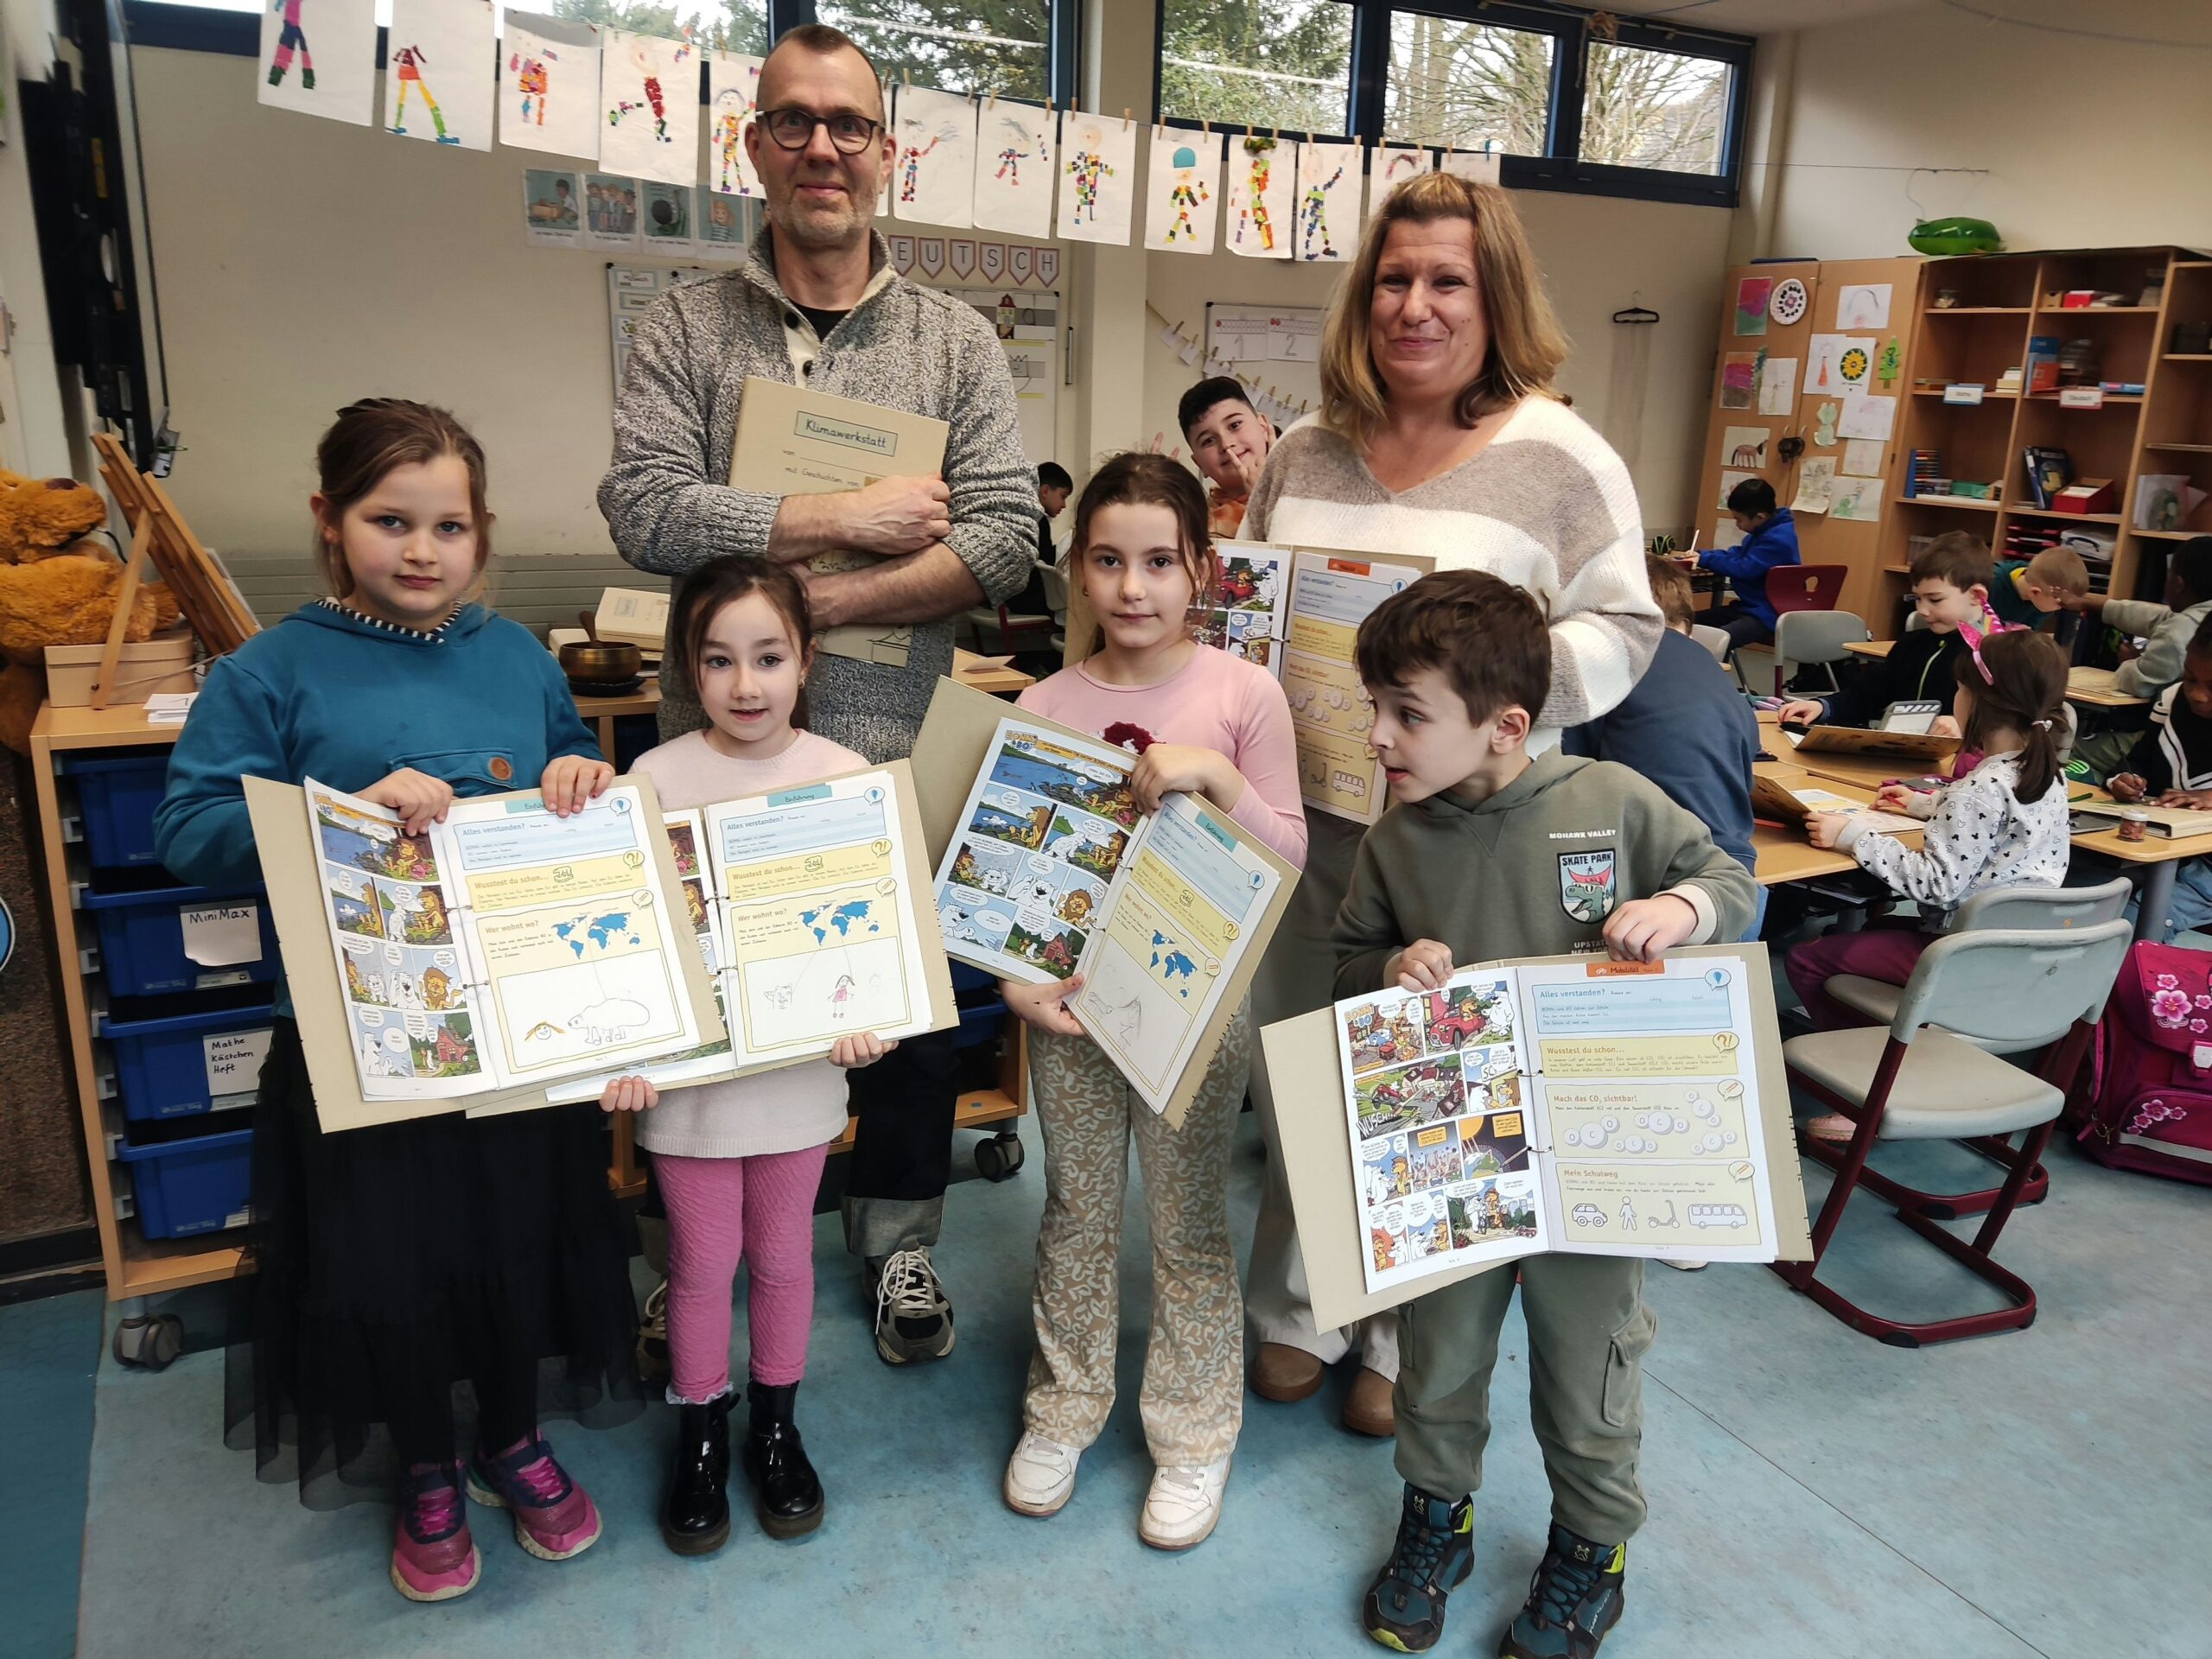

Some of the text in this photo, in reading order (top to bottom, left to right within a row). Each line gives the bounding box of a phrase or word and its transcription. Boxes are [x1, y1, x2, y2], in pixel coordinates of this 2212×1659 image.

[897, 241, 1053, 272] EUTSCH
[805, 419, 887, 448] Klimawerkstatt
[745, 816, 784, 828] verstanden?
[483, 823, 525, 833] verstanden?
[1586, 830, 1617, 838] VALLEY
[1561, 853, 1612, 866] SKATE PARK
[732, 870, 762, 880] Wusstest
[474, 880, 508, 889] Wusstest
[189, 908, 250, 924] MiniMax
[753, 910, 772, 918] wohnt
[774, 907, 787, 916] wo?
[501, 922, 523, 931] wohnt
[525, 919, 539, 928] wo?
[1560, 988, 1605, 997] verstanden?
[212, 1038, 245, 1050] Mathe
[213, 1064, 236, 1074] Heft
[1584, 1169, 1618, 1179] Schulweg
